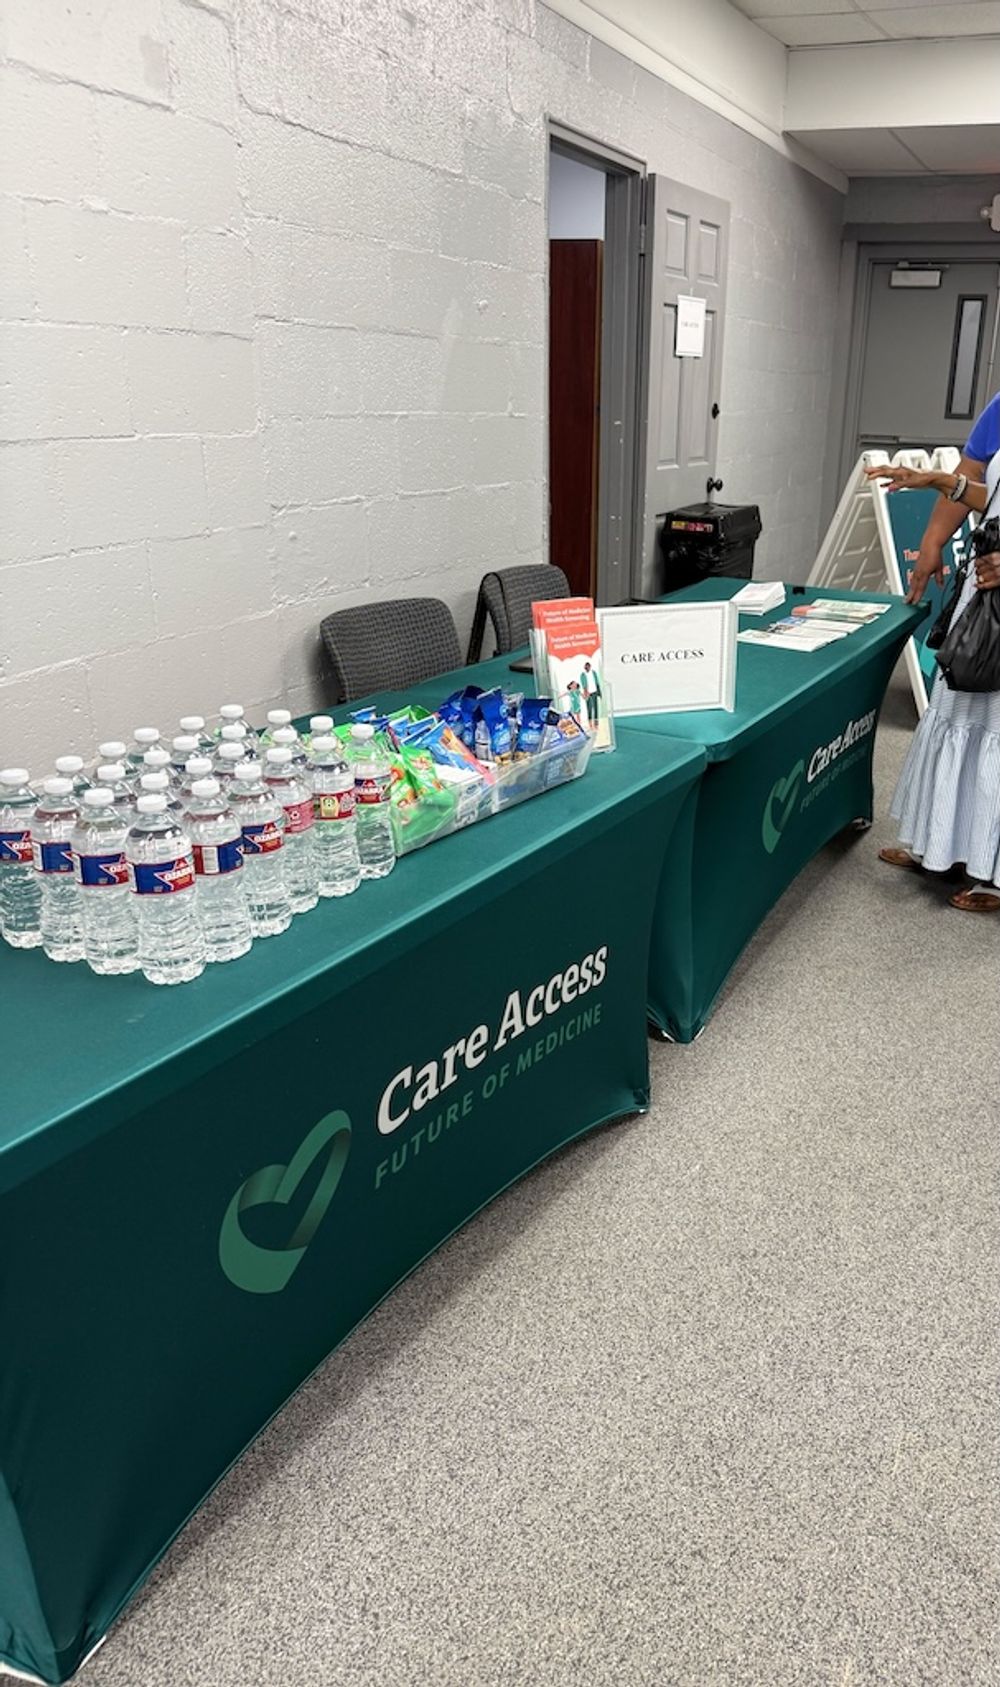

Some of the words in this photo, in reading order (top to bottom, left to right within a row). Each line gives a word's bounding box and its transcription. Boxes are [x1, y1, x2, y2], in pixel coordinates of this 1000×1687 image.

[621, 651, 655, 664] CARE
[658, 648, 705, 661] ACCESS
[807, 735, 842, 783] Care
[840, 708, 877, 754] Access
[374, 1090, 475, 1190] FUTURE
[482, 1063, 510, 1099] OF
[516, 1003, 603, 1077] MEDICINE
[376, 1024, 489, 1135] Care
[493, 945, 608, 1051] Access
